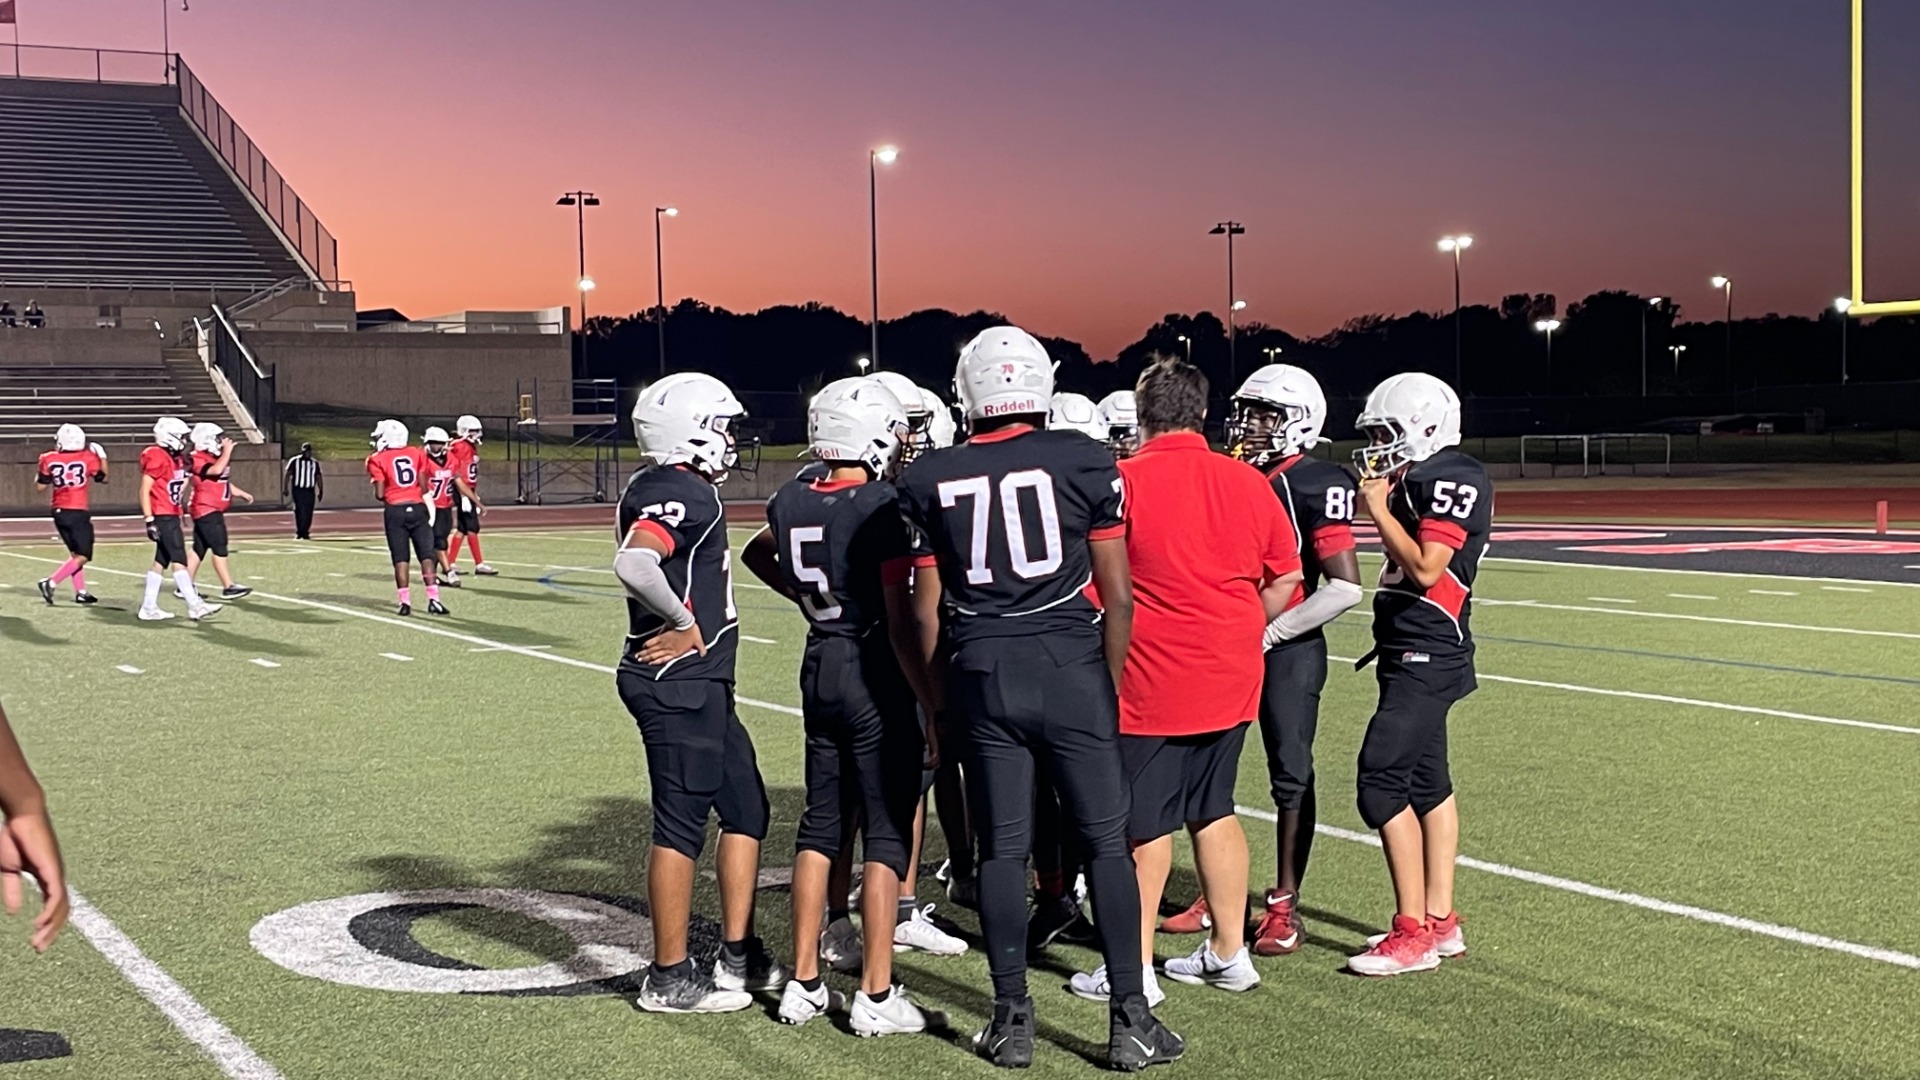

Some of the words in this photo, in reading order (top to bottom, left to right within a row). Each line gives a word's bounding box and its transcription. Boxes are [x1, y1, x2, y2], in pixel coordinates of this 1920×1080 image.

[1001, 364, 1015, 375] 70
[984, 400, 1035, 417] Riddell
[393, 456, 416, 488] 6
[1431, 480, 1478, 519] 53
[938, 469, 1063, 585] 70
[790, 526, 842, 621] 5
